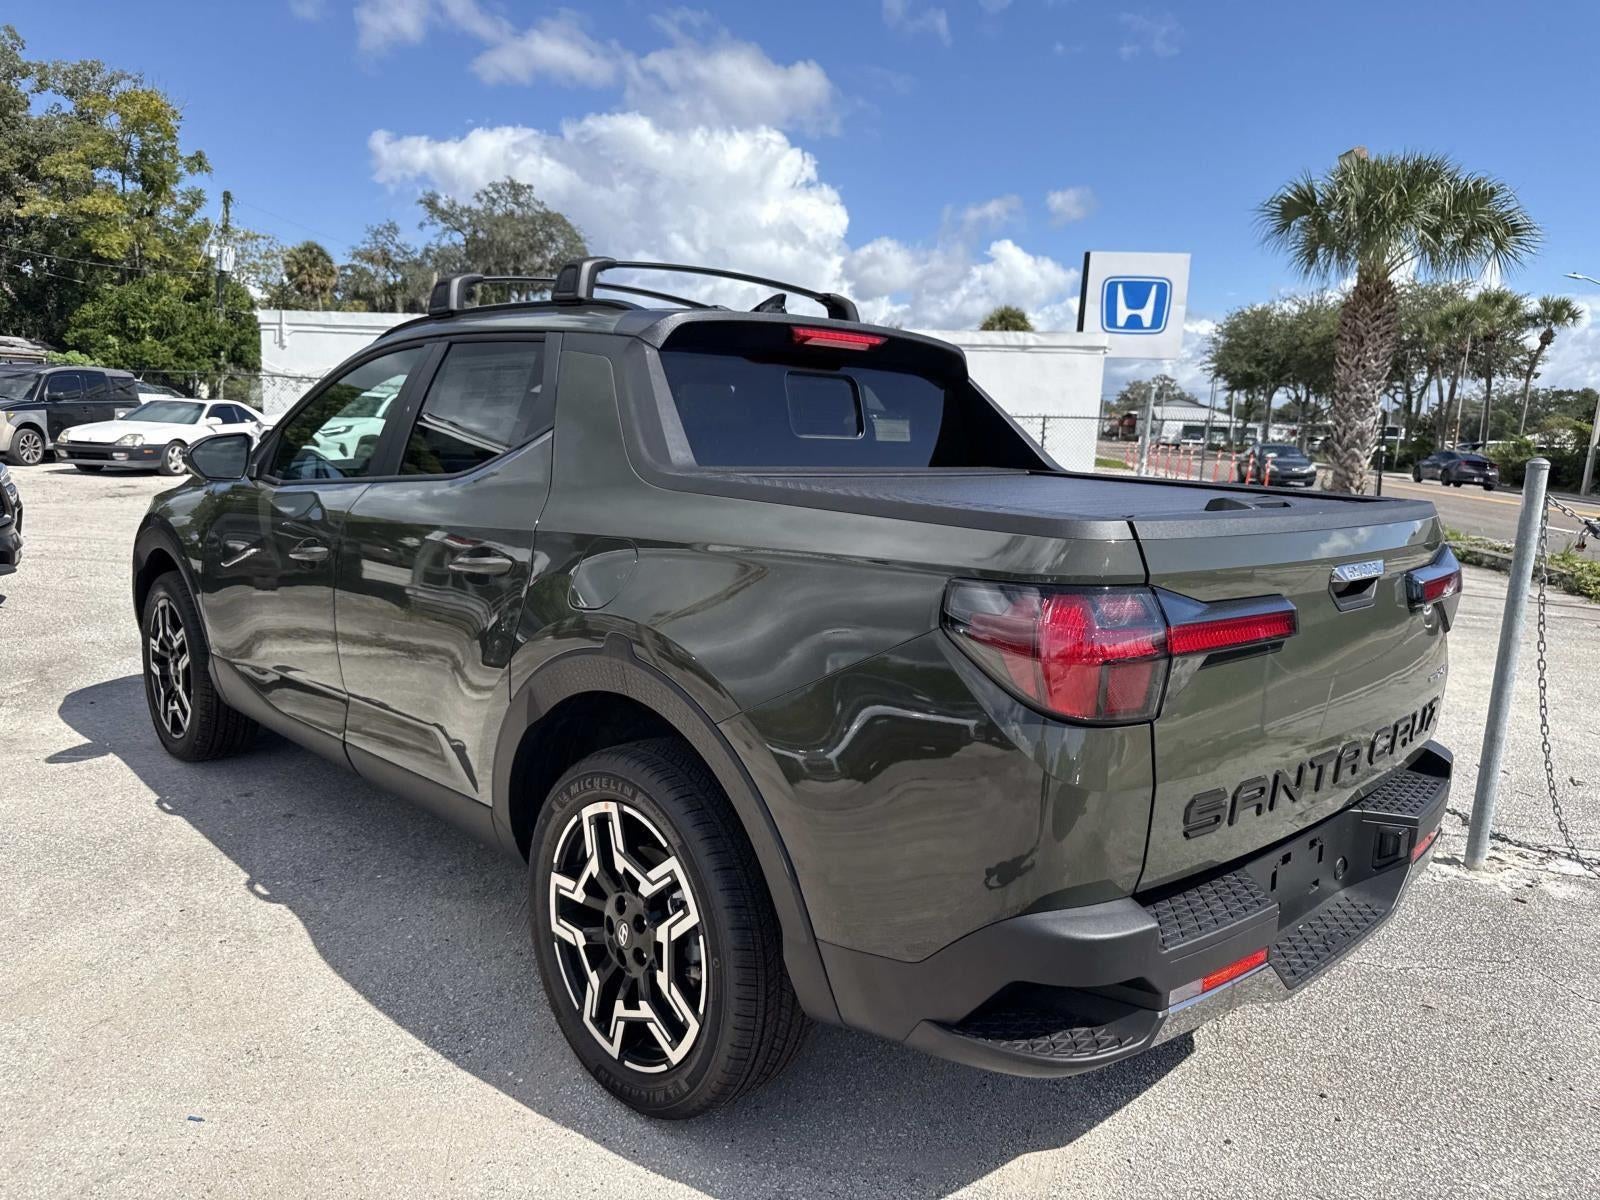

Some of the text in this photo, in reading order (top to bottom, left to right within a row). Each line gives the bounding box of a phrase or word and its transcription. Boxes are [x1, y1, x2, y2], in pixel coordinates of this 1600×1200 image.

[570, 777, 633, 798] MICHELIN
[1182, 695, 1440, 840] SANTA CRUZ
